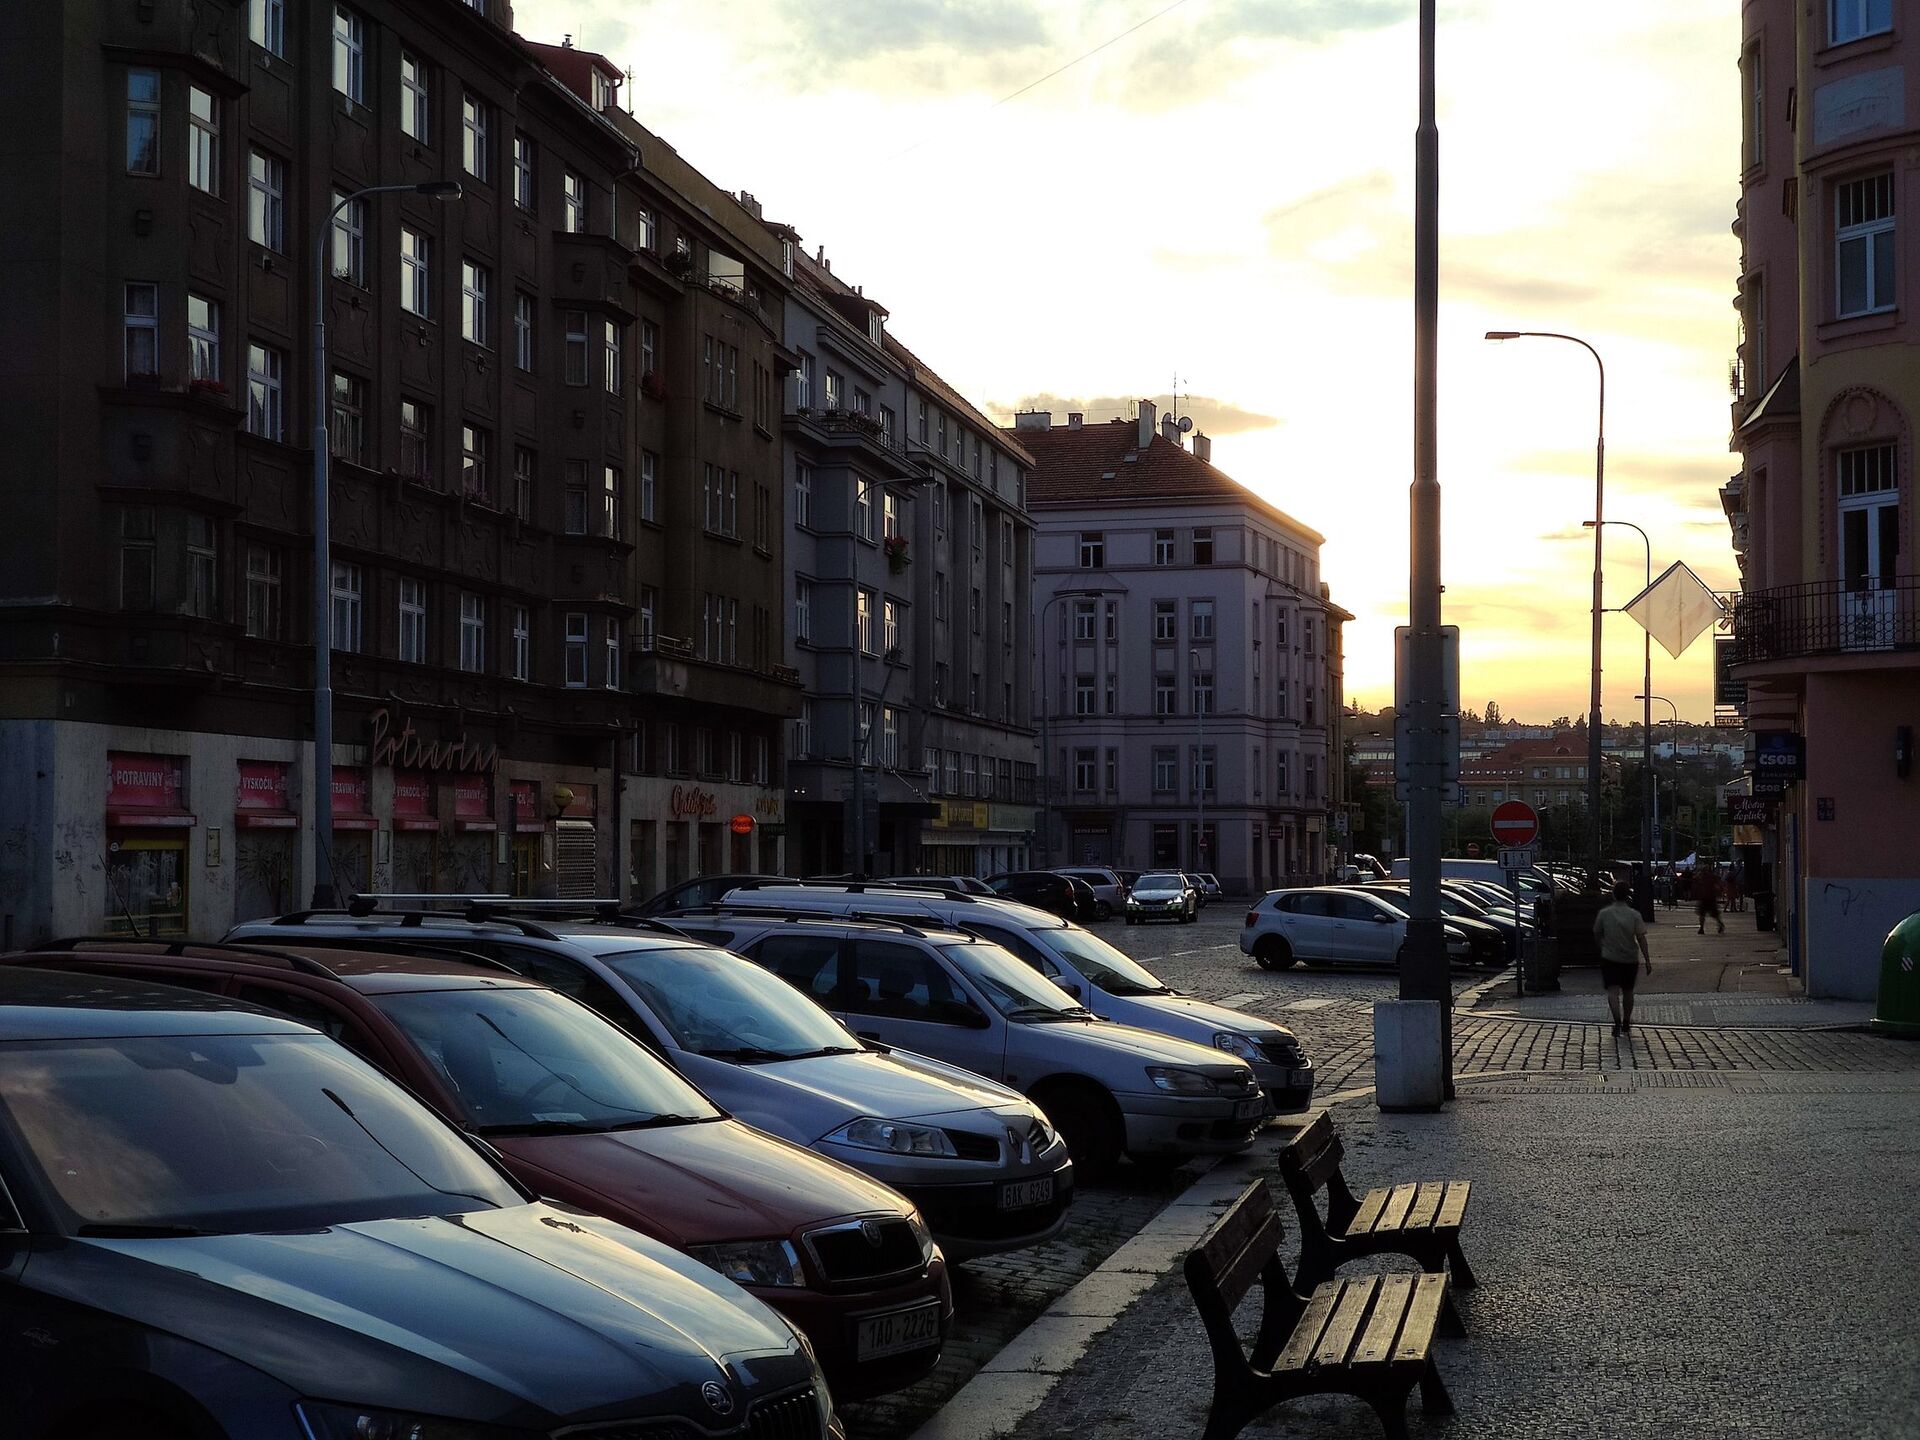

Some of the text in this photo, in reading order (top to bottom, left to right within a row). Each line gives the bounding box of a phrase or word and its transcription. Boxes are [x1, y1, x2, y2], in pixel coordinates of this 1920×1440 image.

[1759, 753, 1797, 765] ČSOB
[116, 769, 164, 787] POTRAVINY
[242, 775, 274, 790] VYSKOČIL
[331, 782, 355, 795] TRAVINY
